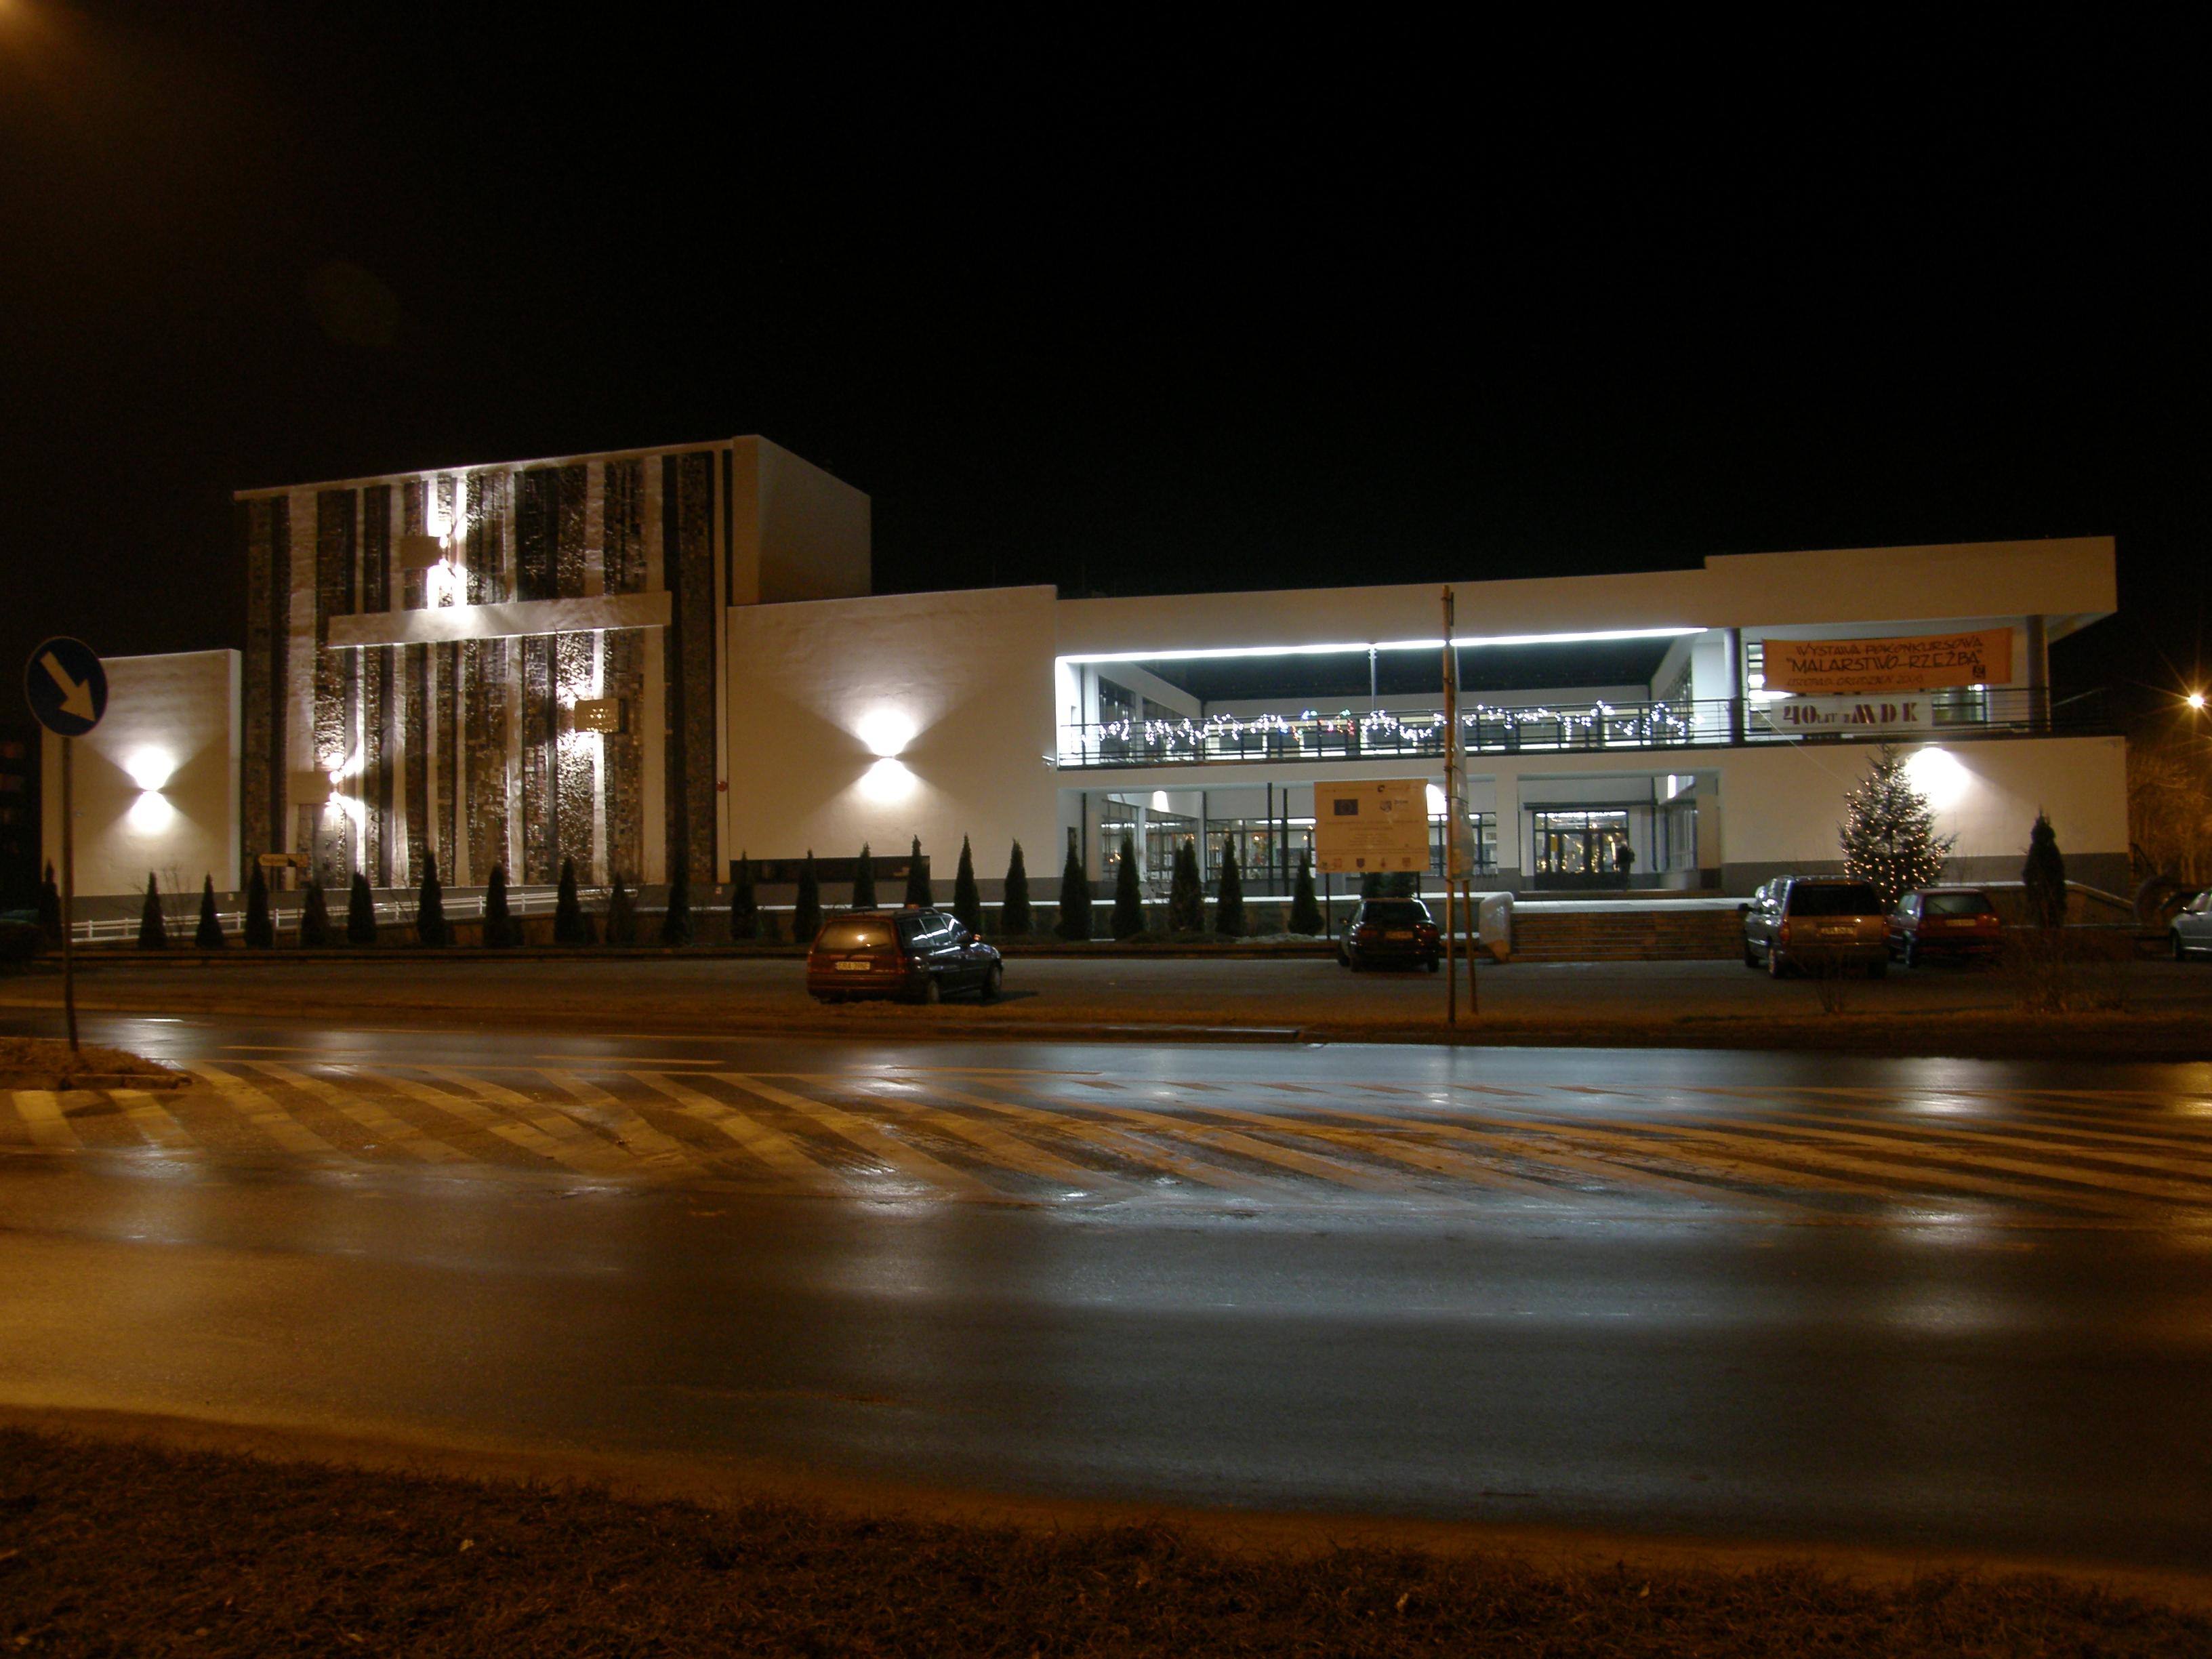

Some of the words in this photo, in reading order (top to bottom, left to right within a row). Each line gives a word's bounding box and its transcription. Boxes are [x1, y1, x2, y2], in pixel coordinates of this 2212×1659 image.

[1796, 643, 1861, 656] WYSTAWA
[1865, 638, 1983, 655] POKONKURSOWA
[1783, 705, 1817, 724] 40
[1851, 702, 1919, 724] MDK
